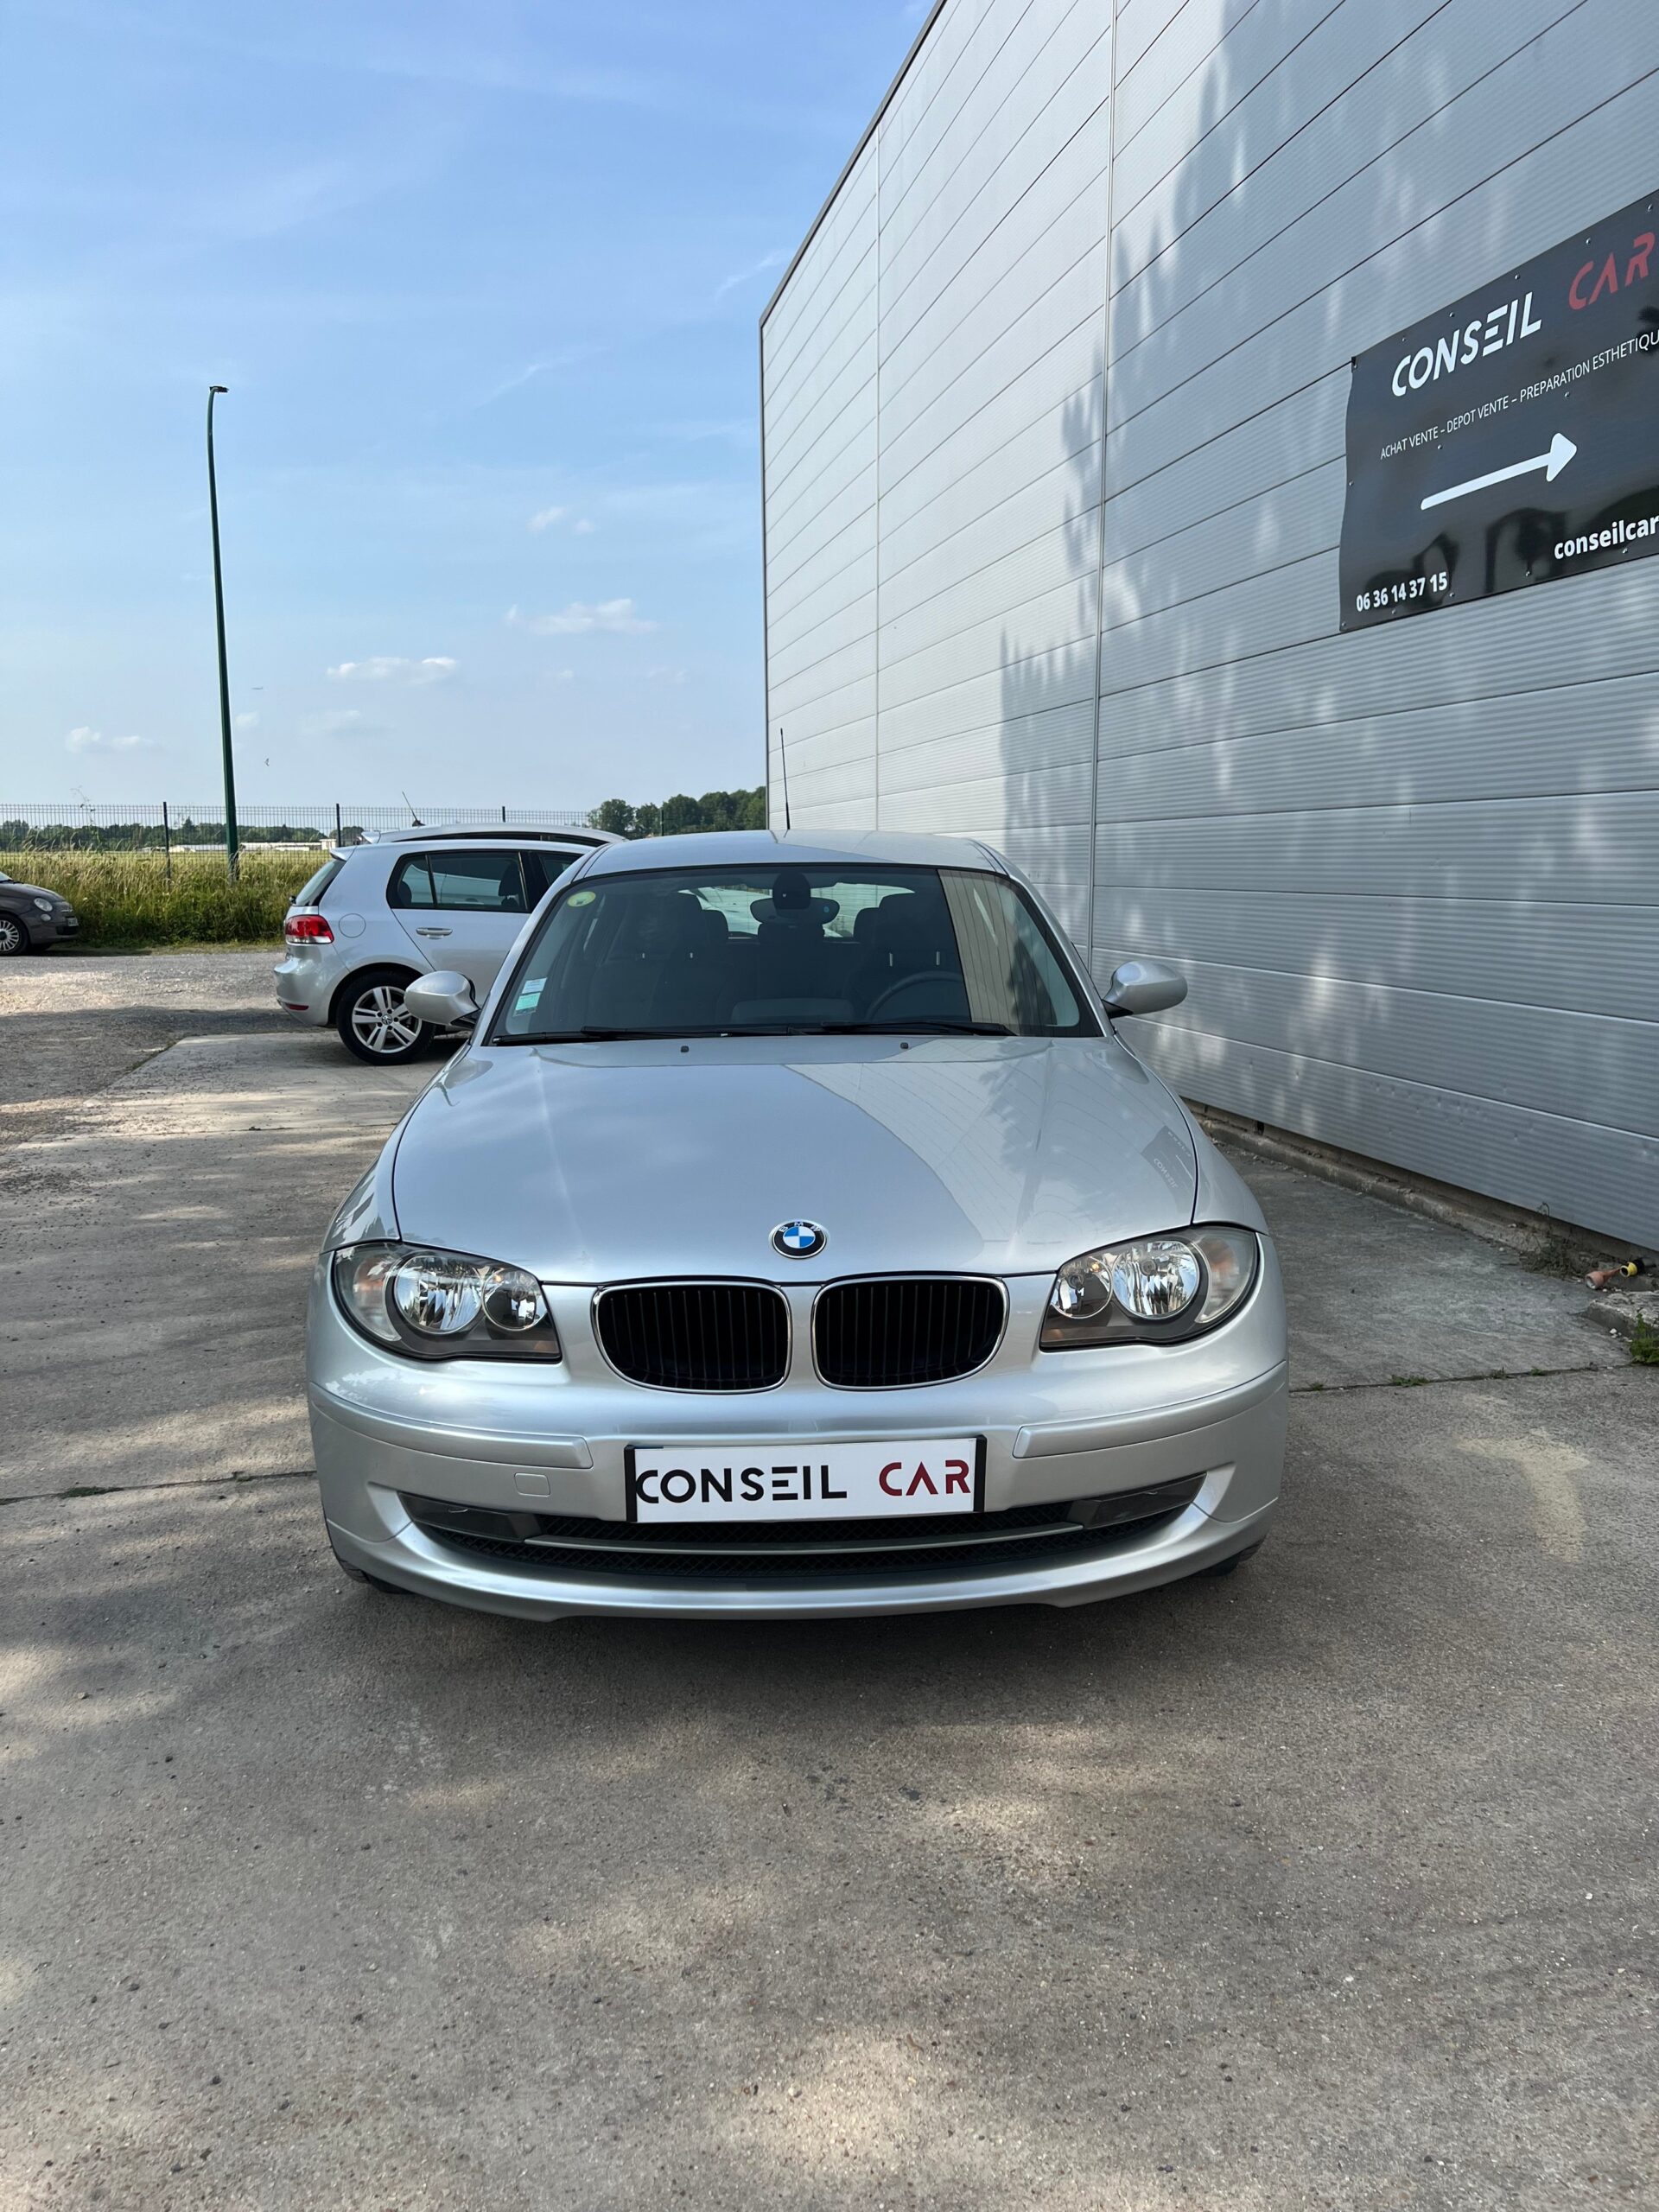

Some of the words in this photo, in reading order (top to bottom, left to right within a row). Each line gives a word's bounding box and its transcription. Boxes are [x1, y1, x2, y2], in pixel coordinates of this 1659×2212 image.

[1392, 292, 1541, 397] CONSEIL
[1568, 232, 1656, 310] CAR
[1380, 438, 1408, 460] ACHAT
[1408, 426, 1439, 448] VENTE
[1446, 409, 1476, 433] DEPOT
[1477, 395, 1510, 419] VENTE
[1520, 359, 1590, 402] PREPARATION
[1356, 592, 1370, 612] 06
[1373, 588, 1389, 607] 36
[1391, 582, 1407, 602] 14
[1408, 577, 1426, 598] 37
[1430, 571, 1448, 592] 15
[779, 1221, 821, 1232] BMW
[636, 1465, 848, 1504] CONSEIL
[879, 1459, 971, 1497] CAR
